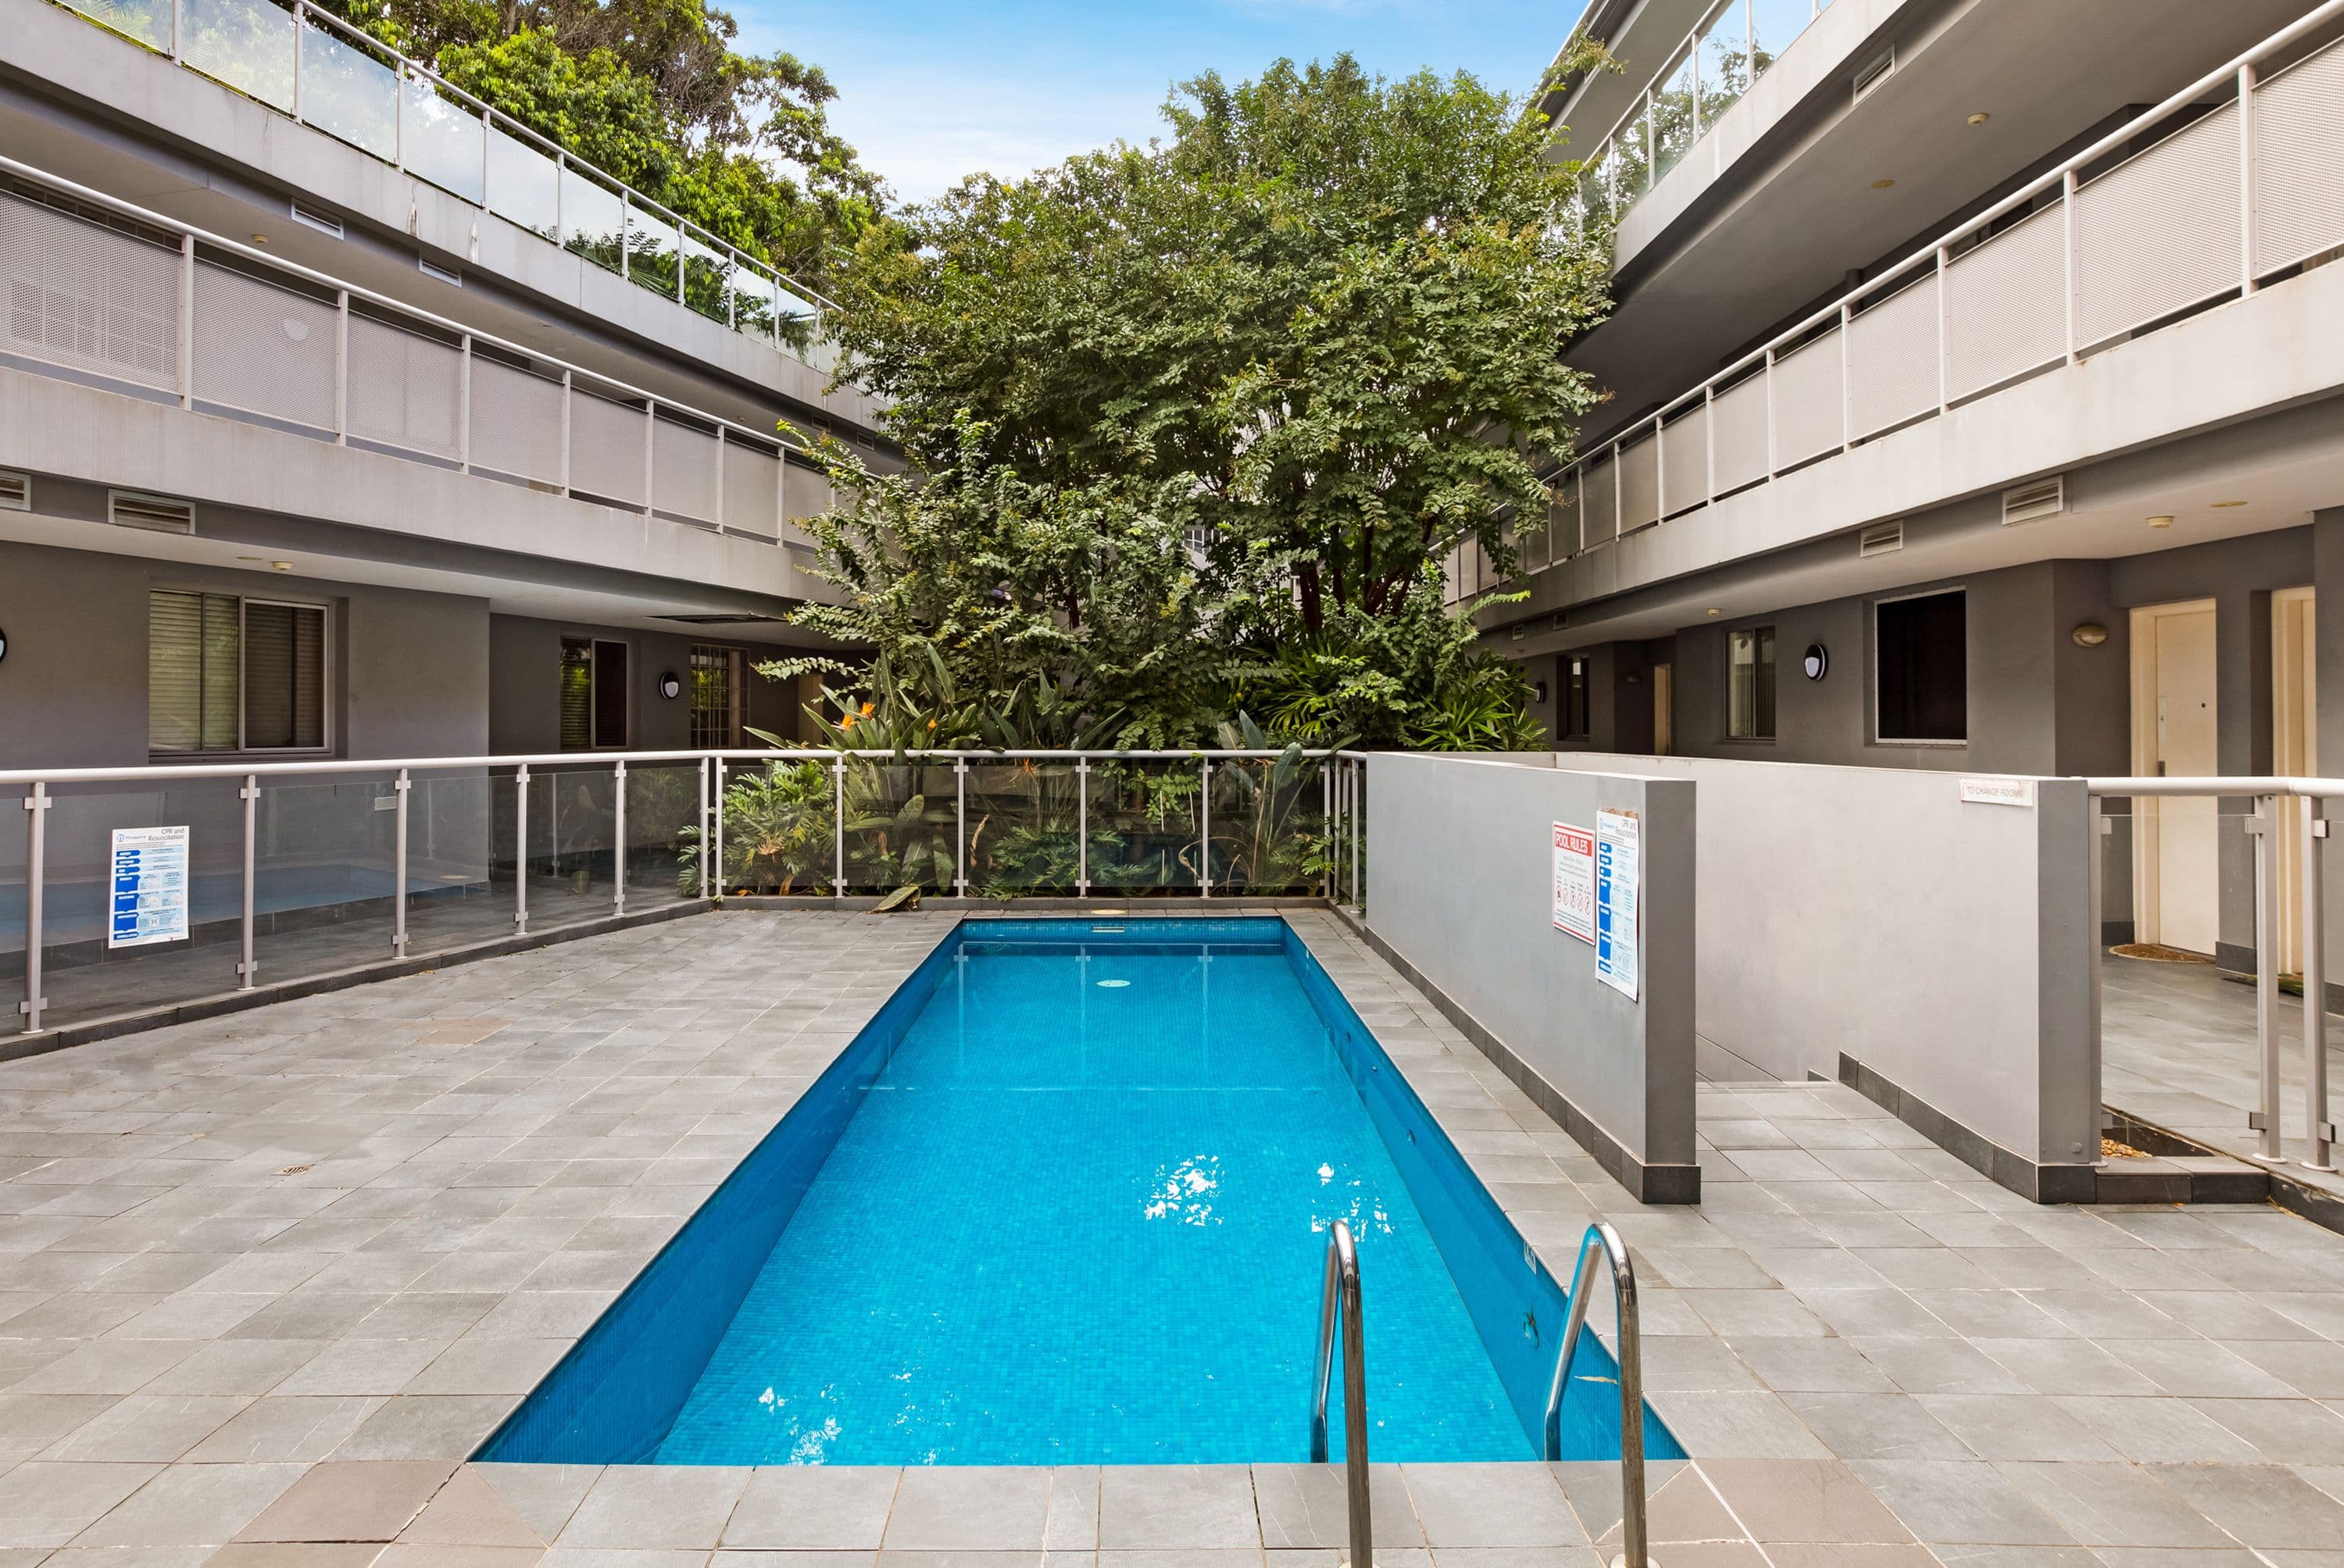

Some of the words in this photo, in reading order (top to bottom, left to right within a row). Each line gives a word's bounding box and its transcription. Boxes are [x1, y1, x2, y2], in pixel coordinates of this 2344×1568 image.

[1975, 788, 1999, 796] CHANGE
[2000, 788, 2024, 798] ROOMS
[1555, 832, 1570, 849] POOL
[1570, 837, 1588, 854] RULES
